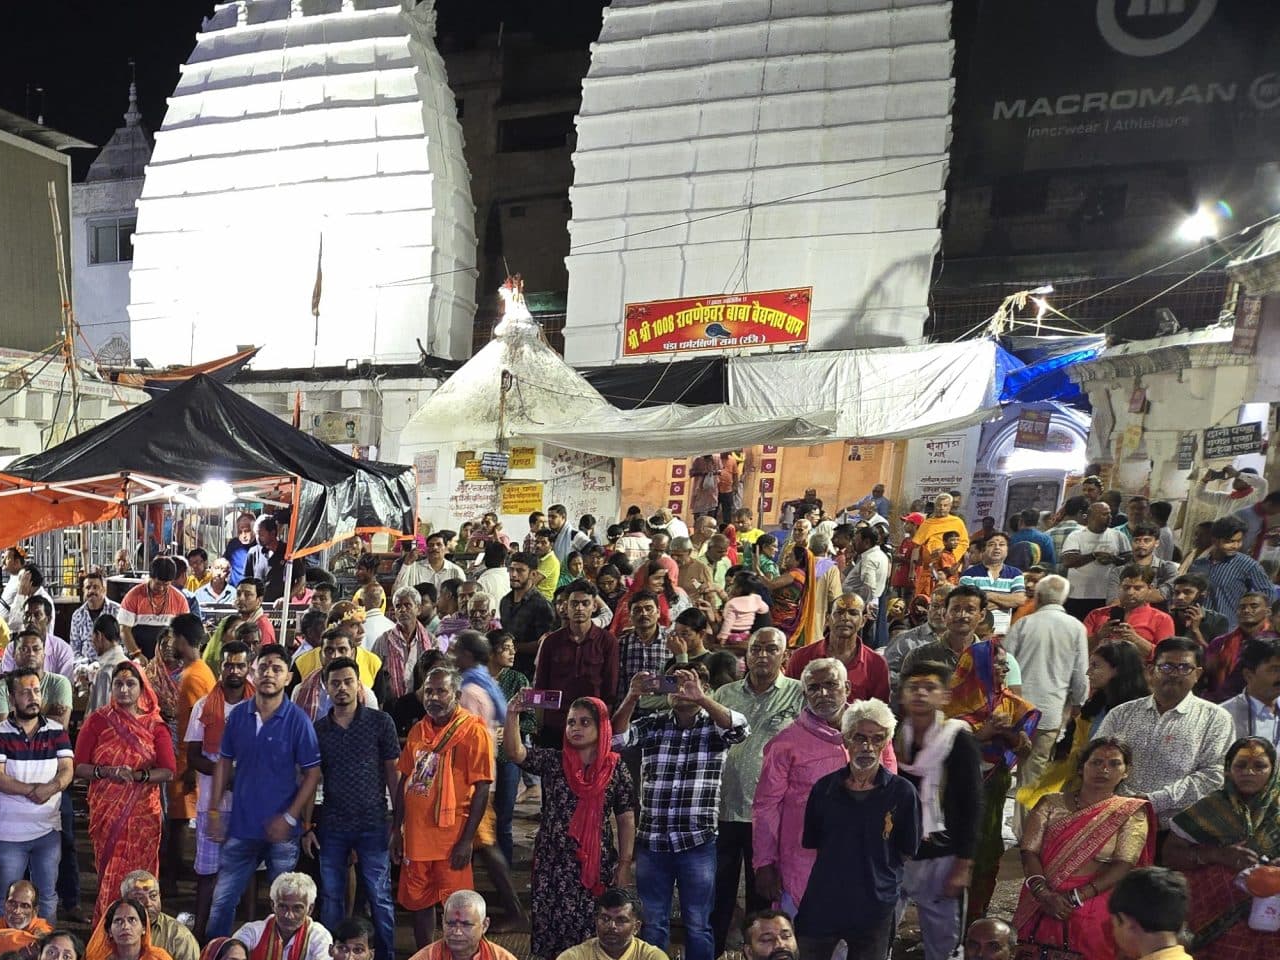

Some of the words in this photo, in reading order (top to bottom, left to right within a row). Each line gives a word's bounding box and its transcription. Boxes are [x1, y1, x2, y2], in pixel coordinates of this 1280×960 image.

[992, 82, 1238, 120] MACROMAN
[1027, 122, 1097, 138] Innerwear
[1112, 115, 1190, 132] Athleisure
[627, 328, 640, 350] श्री
[640, 320, 652, 343] श्री
[652, 314, 675, 339] 1008
[676, 302, 726, 330] रावणेश्वर
[726, 303, 750, 323] बाबा
[786, 313, 805, 338] धाम
